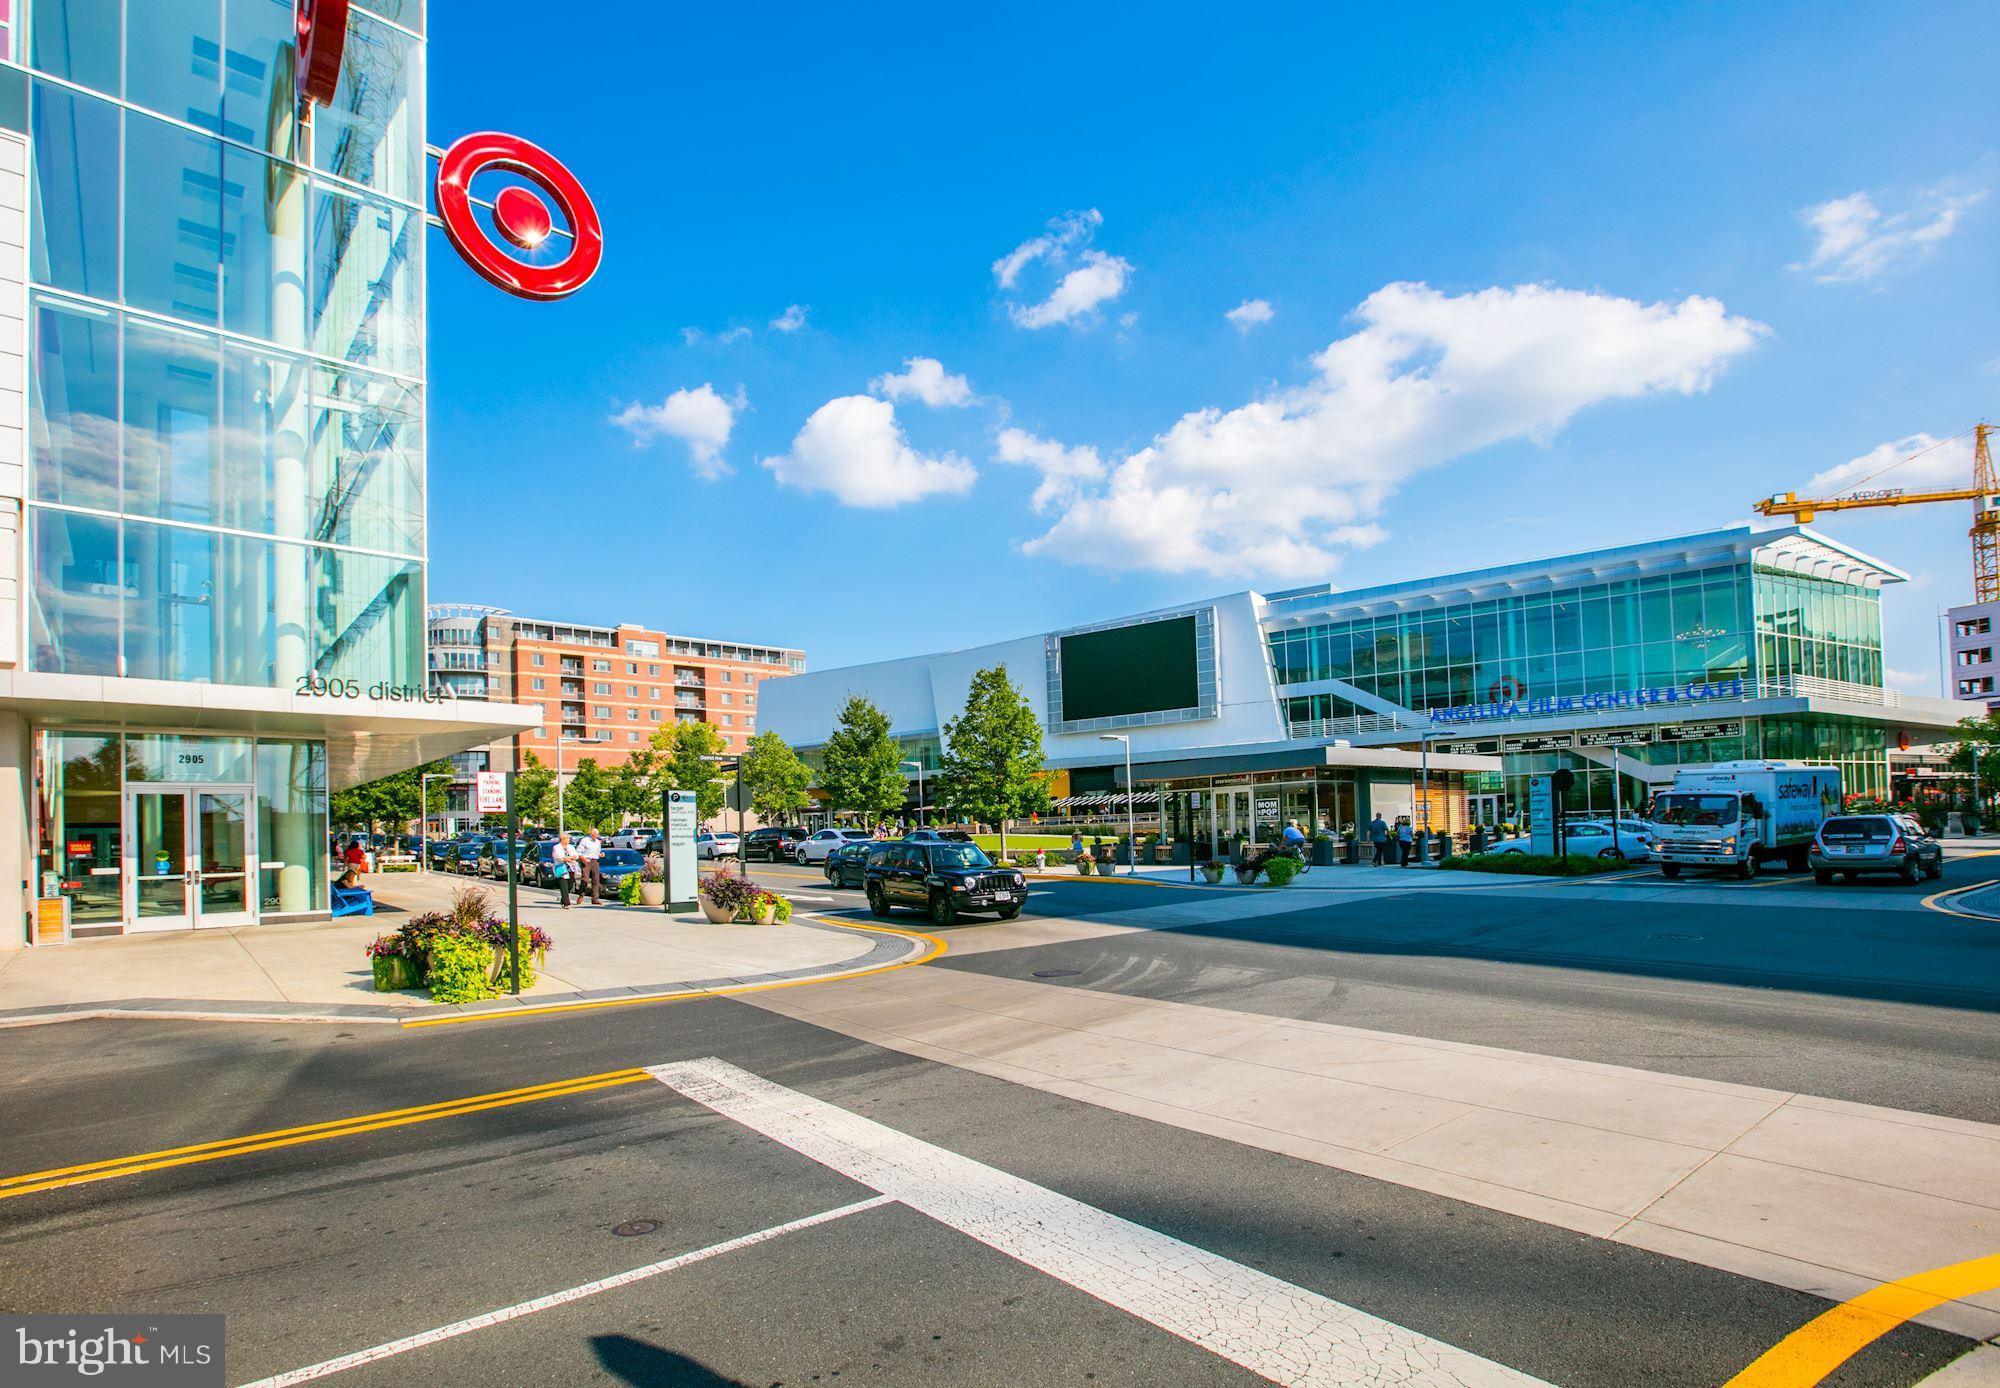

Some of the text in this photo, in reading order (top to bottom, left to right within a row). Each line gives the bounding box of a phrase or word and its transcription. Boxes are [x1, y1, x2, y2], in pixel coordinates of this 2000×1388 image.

[296, 676, 444, 704] 2905 district
[1430, 704, 1521, 723] ANGELIKA
[1528, 697, 1573, 714] FILM
[1581, 689, 1660, 708] CENTER
[178, 755, 204, 764] 2905
[1778, 778, 1811, 801] safeway
[1258, 801, 1277, 809] MOM
